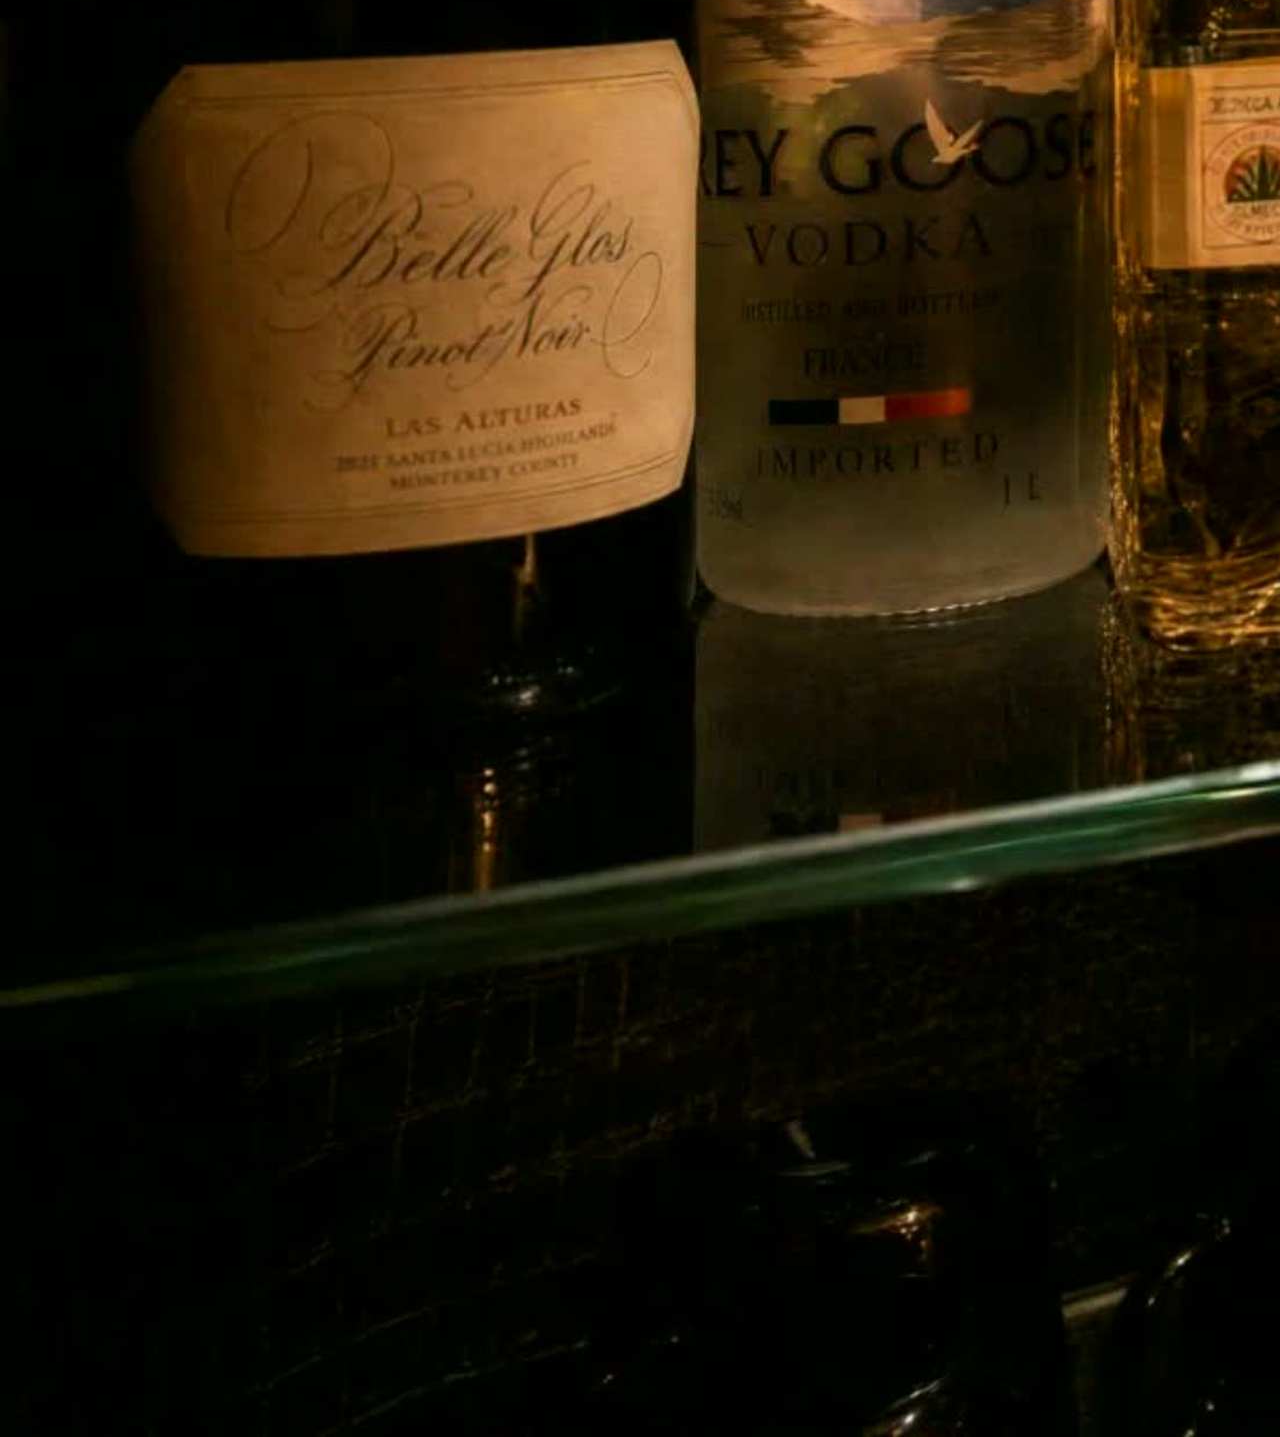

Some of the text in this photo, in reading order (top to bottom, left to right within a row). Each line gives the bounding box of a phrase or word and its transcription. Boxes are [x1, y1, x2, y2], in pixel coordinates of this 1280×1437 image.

[745, 212, 993, 265] VODKA
[383, 398, 583, 439] LAS ALTURAS
[755, 432, 1000, 476] IMPORTED
